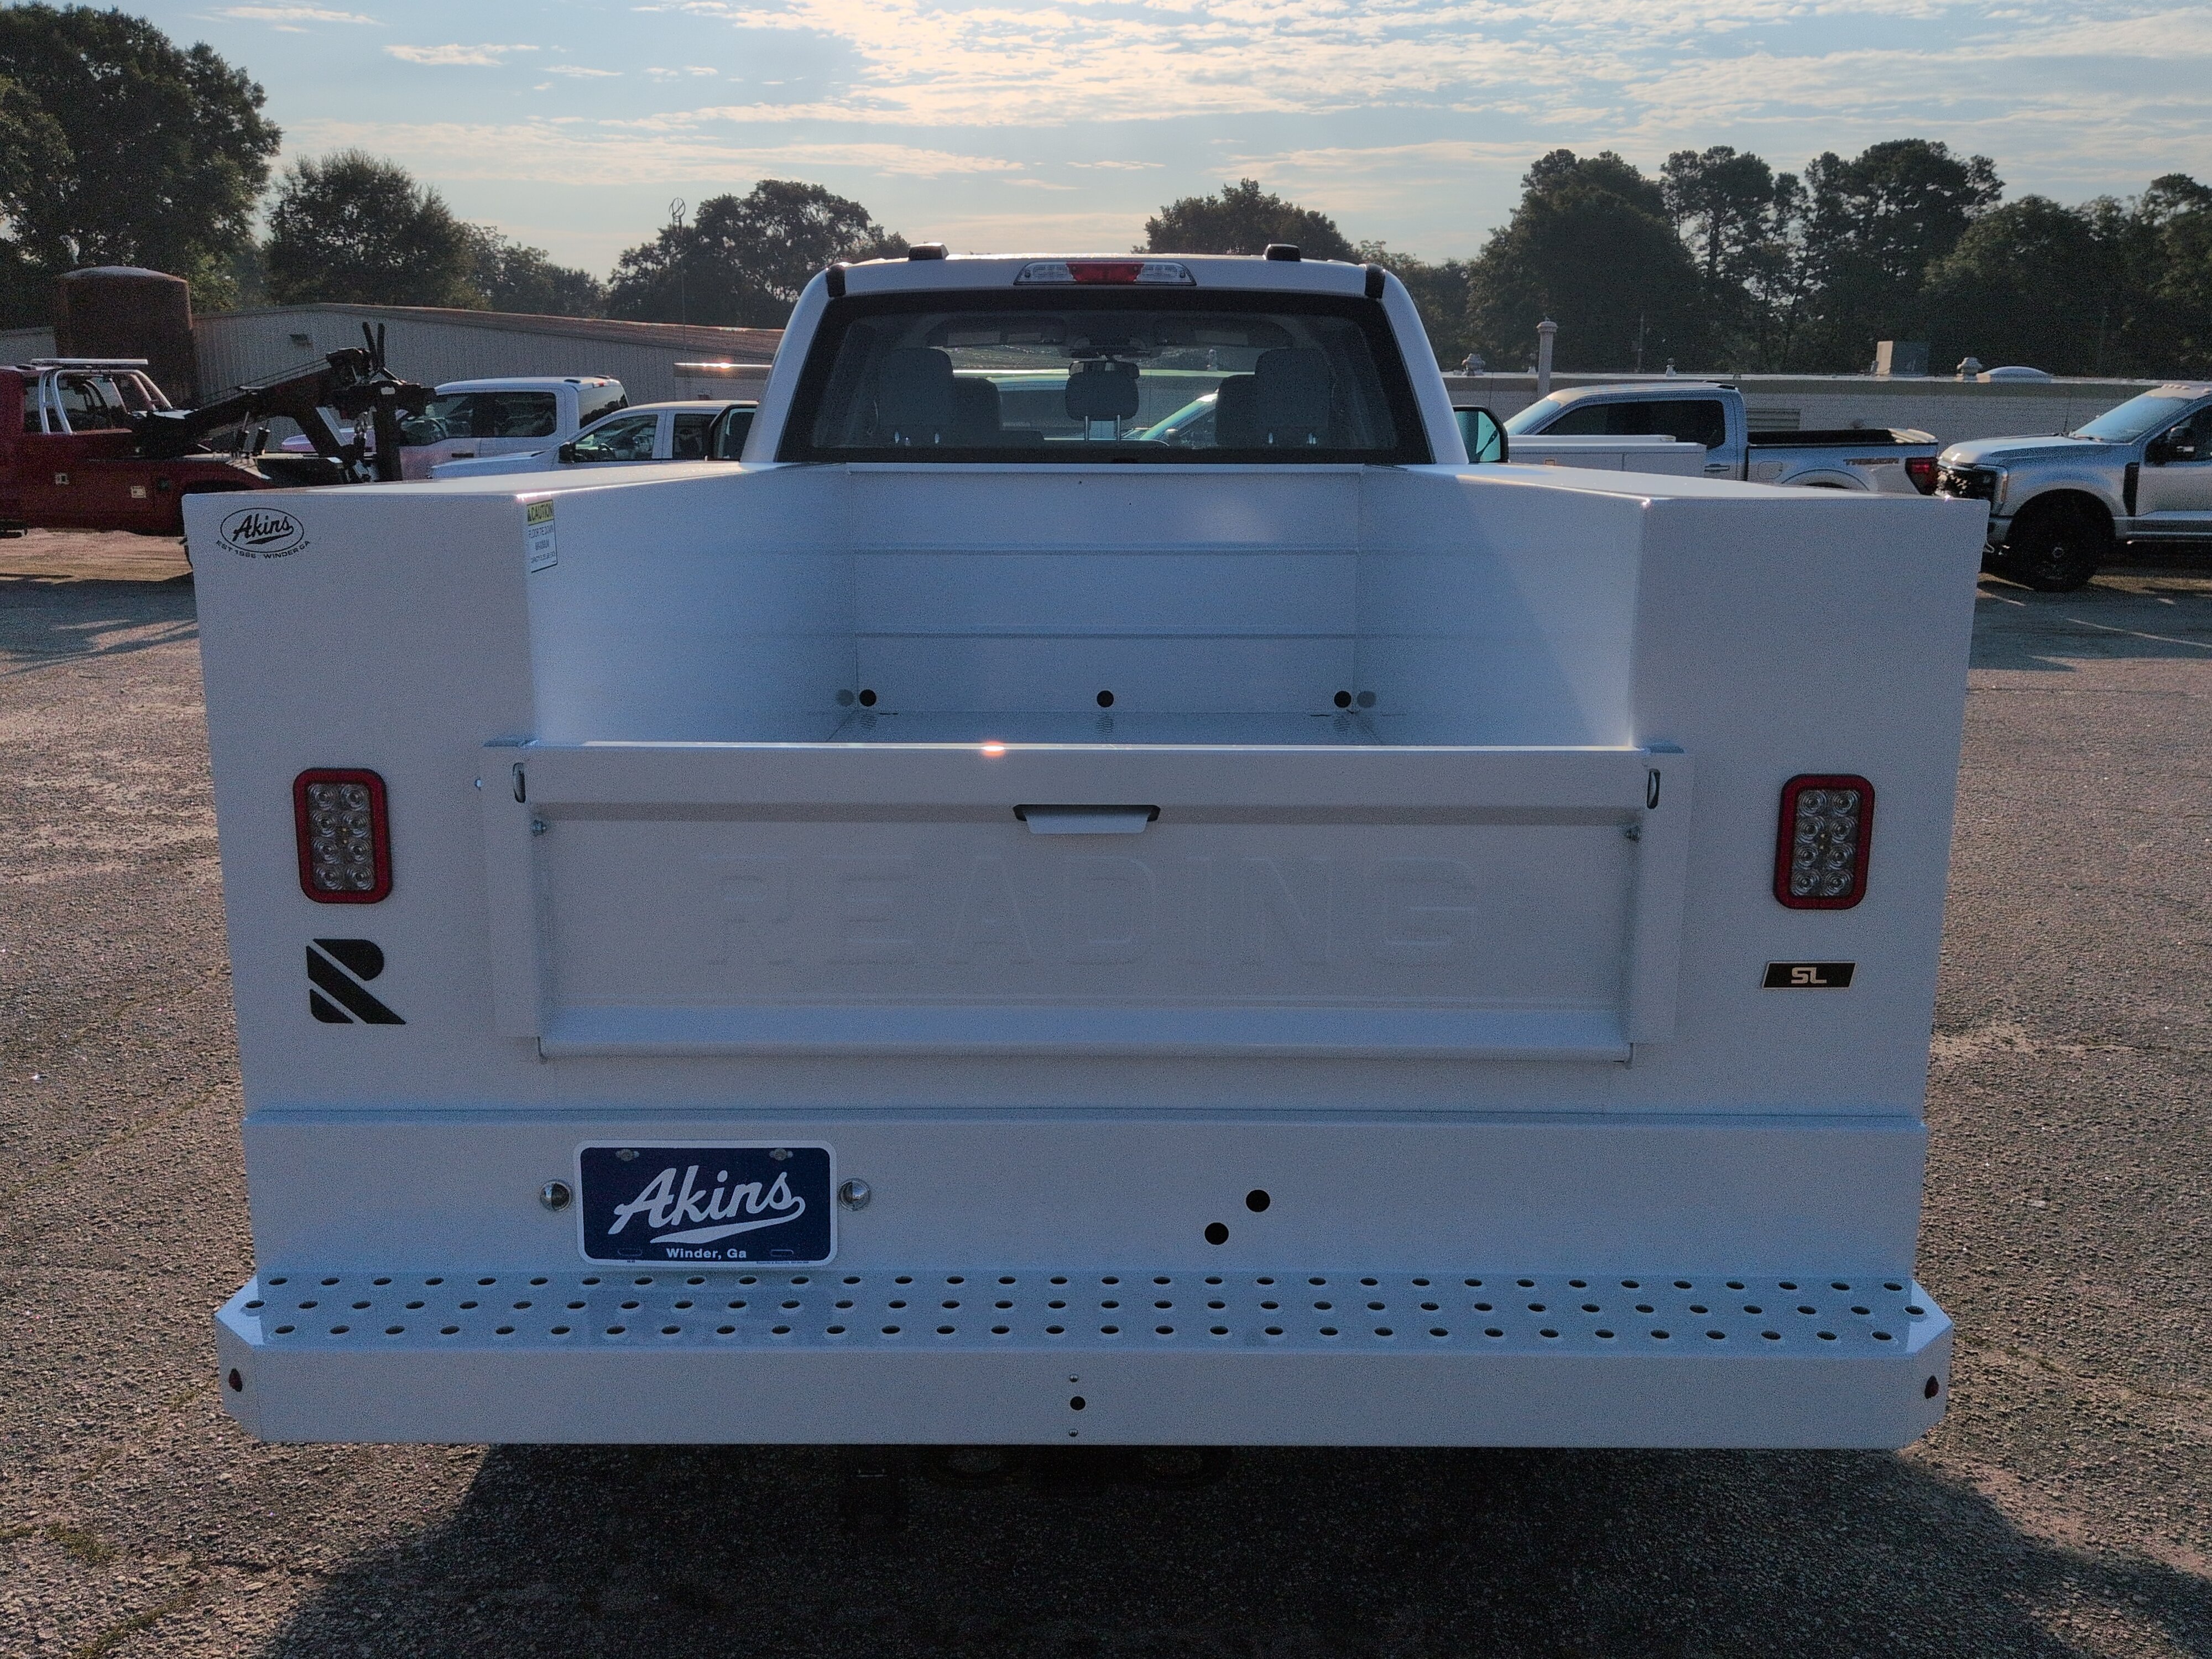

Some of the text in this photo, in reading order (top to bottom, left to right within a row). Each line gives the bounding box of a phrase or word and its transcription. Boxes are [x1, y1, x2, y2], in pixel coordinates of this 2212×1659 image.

[531, 502, 554, 521] CAUTION
[232, 513, 294, 544] Akins
[216, 540, 233, 552] EST
[263, 547, 299, 559] WINDER
[299, 540, 311, 551] GA
[699, 854, 1479, 967] READING
[1791, 967, 1827, 984] SL
[608, 1165, 806, 1244] Akins
[666, 1248, 747, 1260] Winder, Ga
